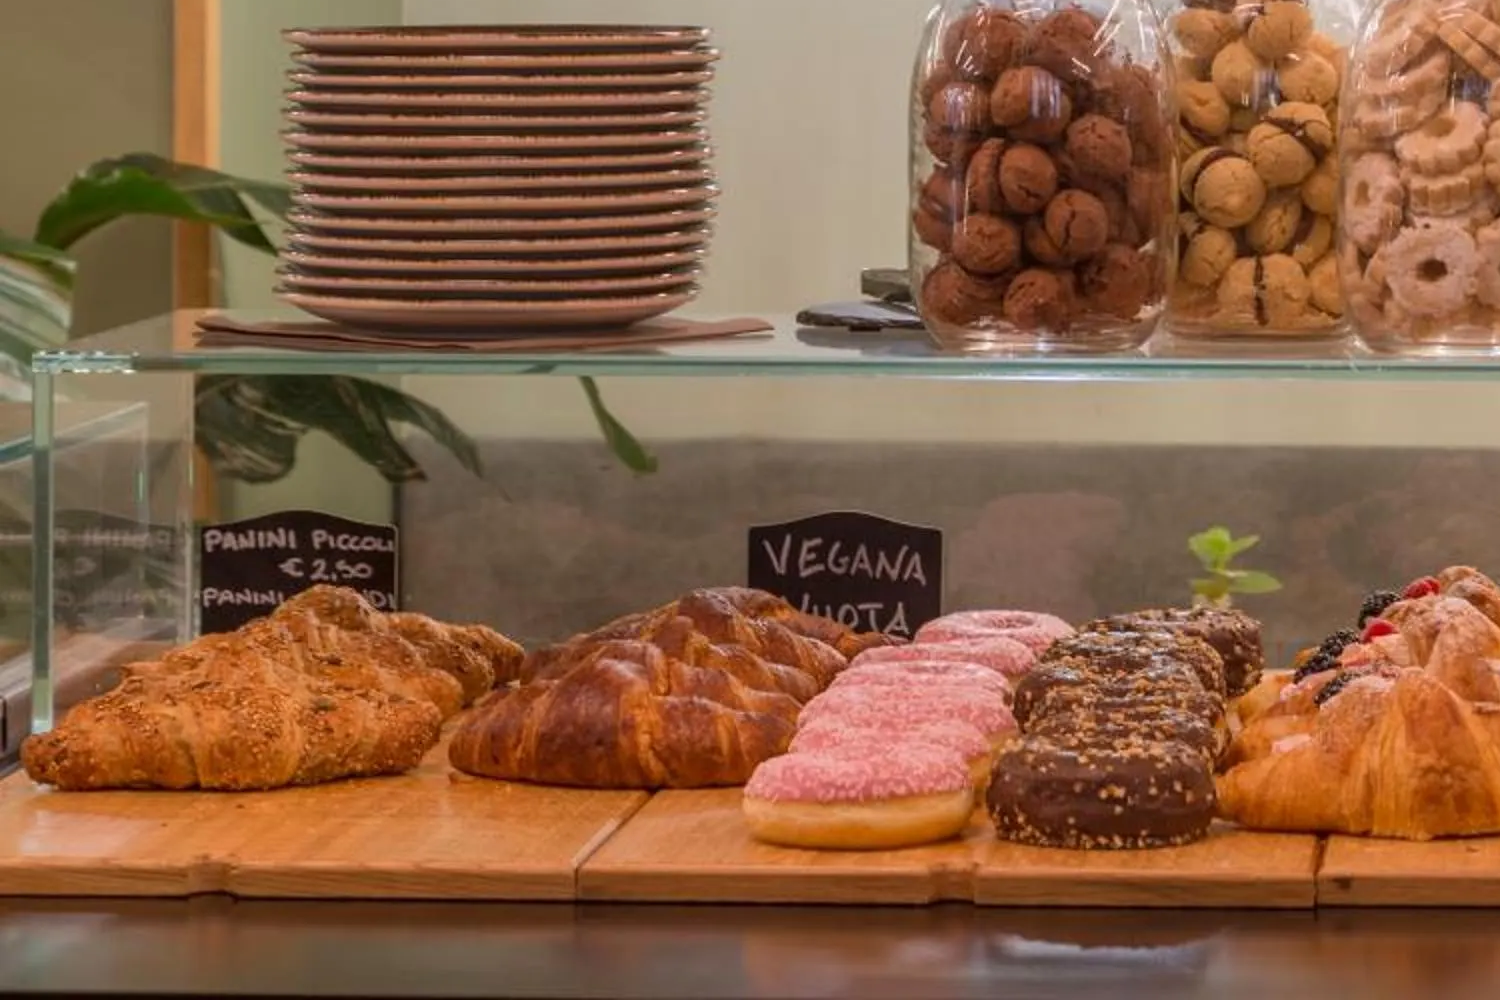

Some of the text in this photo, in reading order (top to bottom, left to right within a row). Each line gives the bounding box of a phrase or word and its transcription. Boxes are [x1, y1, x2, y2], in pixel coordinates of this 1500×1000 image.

[204, 527, 297, 552] PANINI
[762, 533, 927, 586] VEGANA
[202, 587, 284, 608] PANINI
